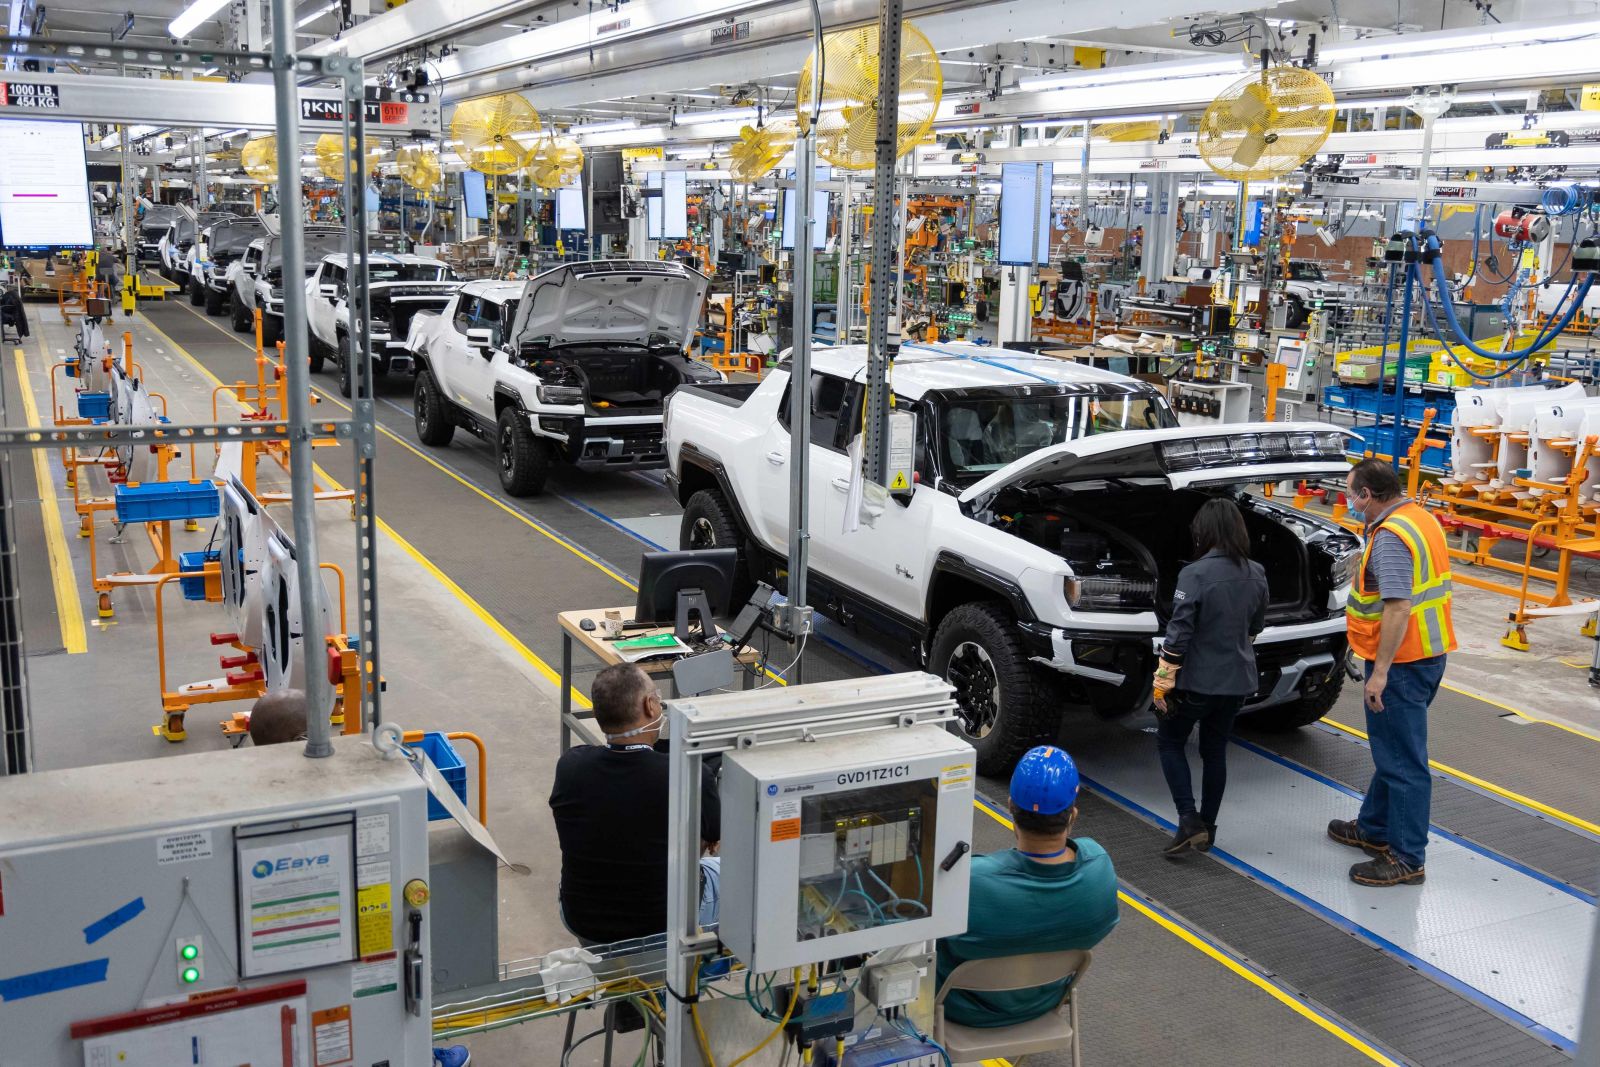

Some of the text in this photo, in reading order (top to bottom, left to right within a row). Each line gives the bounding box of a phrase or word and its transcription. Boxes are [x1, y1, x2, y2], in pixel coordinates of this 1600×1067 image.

[10, 84, 35, 95] 1000
[37, 85, 56, 97] LB.
[17, 96, 58, 108] 454 KG.
[311, 102, 378, 115] KNIT
[837, 765, 909, 785] GVD1TZ1C1
